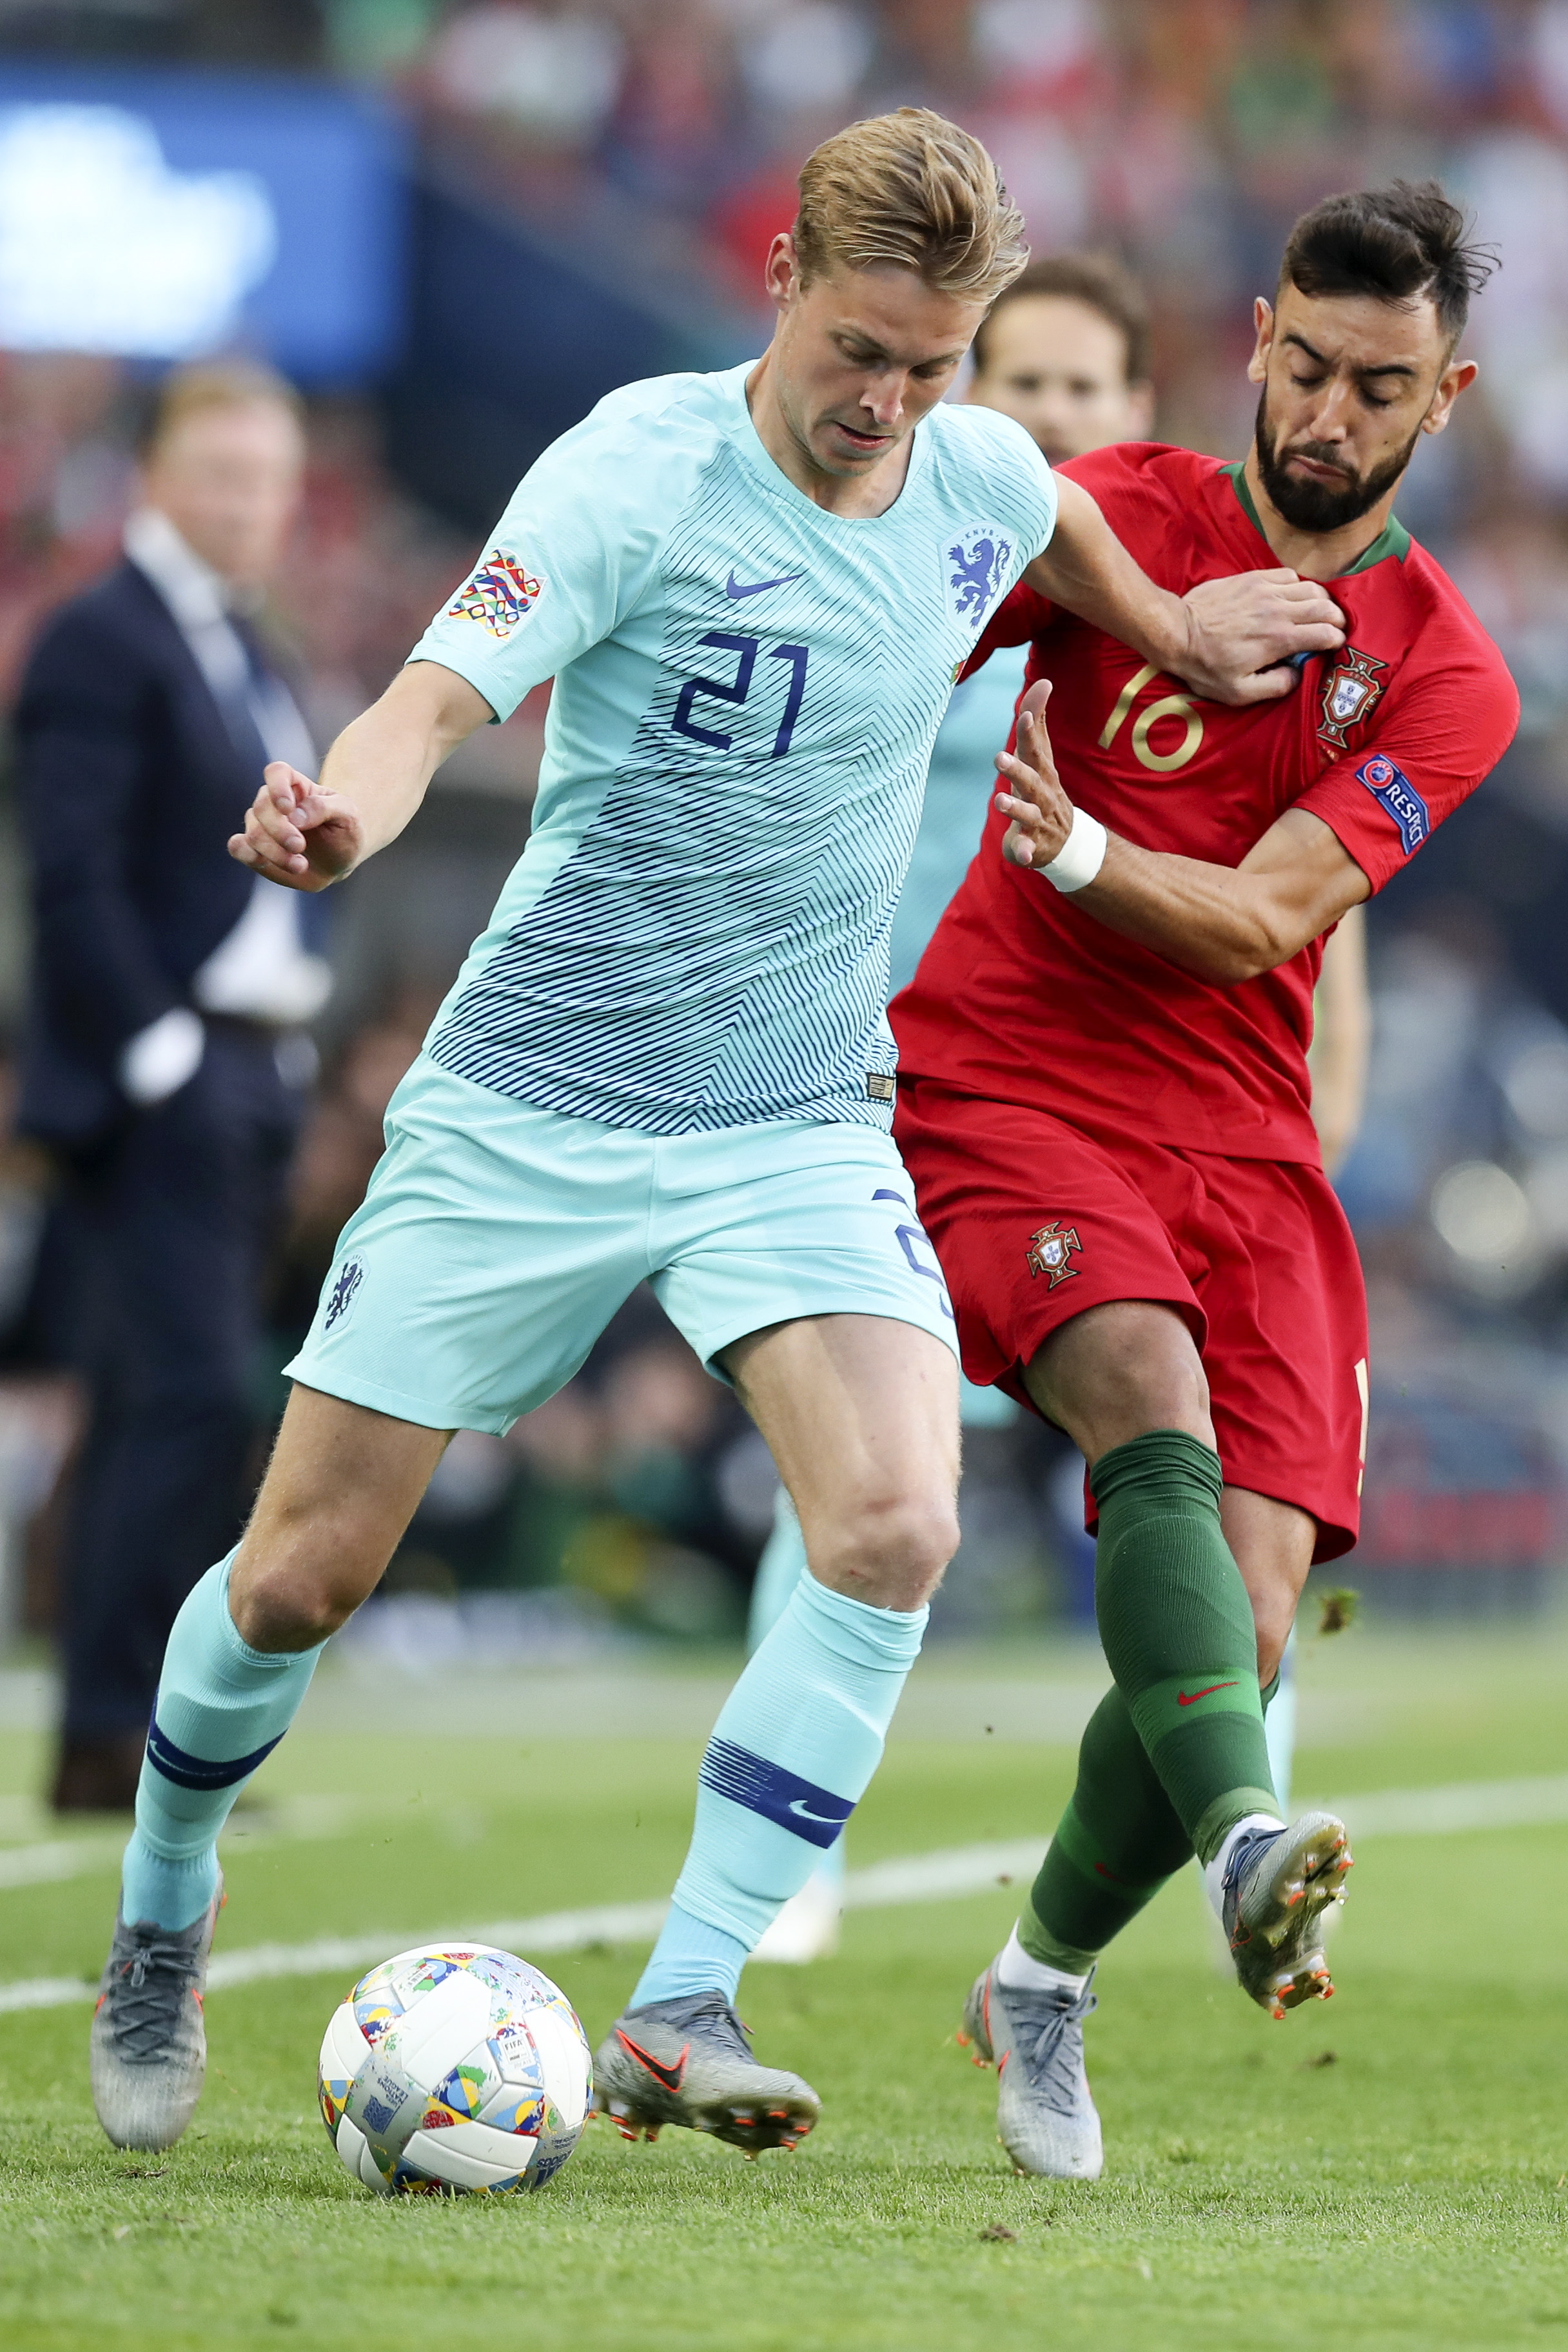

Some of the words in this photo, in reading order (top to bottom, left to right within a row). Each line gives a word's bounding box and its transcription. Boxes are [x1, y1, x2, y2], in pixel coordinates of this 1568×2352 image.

[965, 528, 994, 539] KNVB
[671, 632, 808, 758] 21
[504, 2039, 523, 2050] FIFA
[377, 2077, 404, 2105] NATIONS
[384, 2075, 408, 2102] LEAGUE
